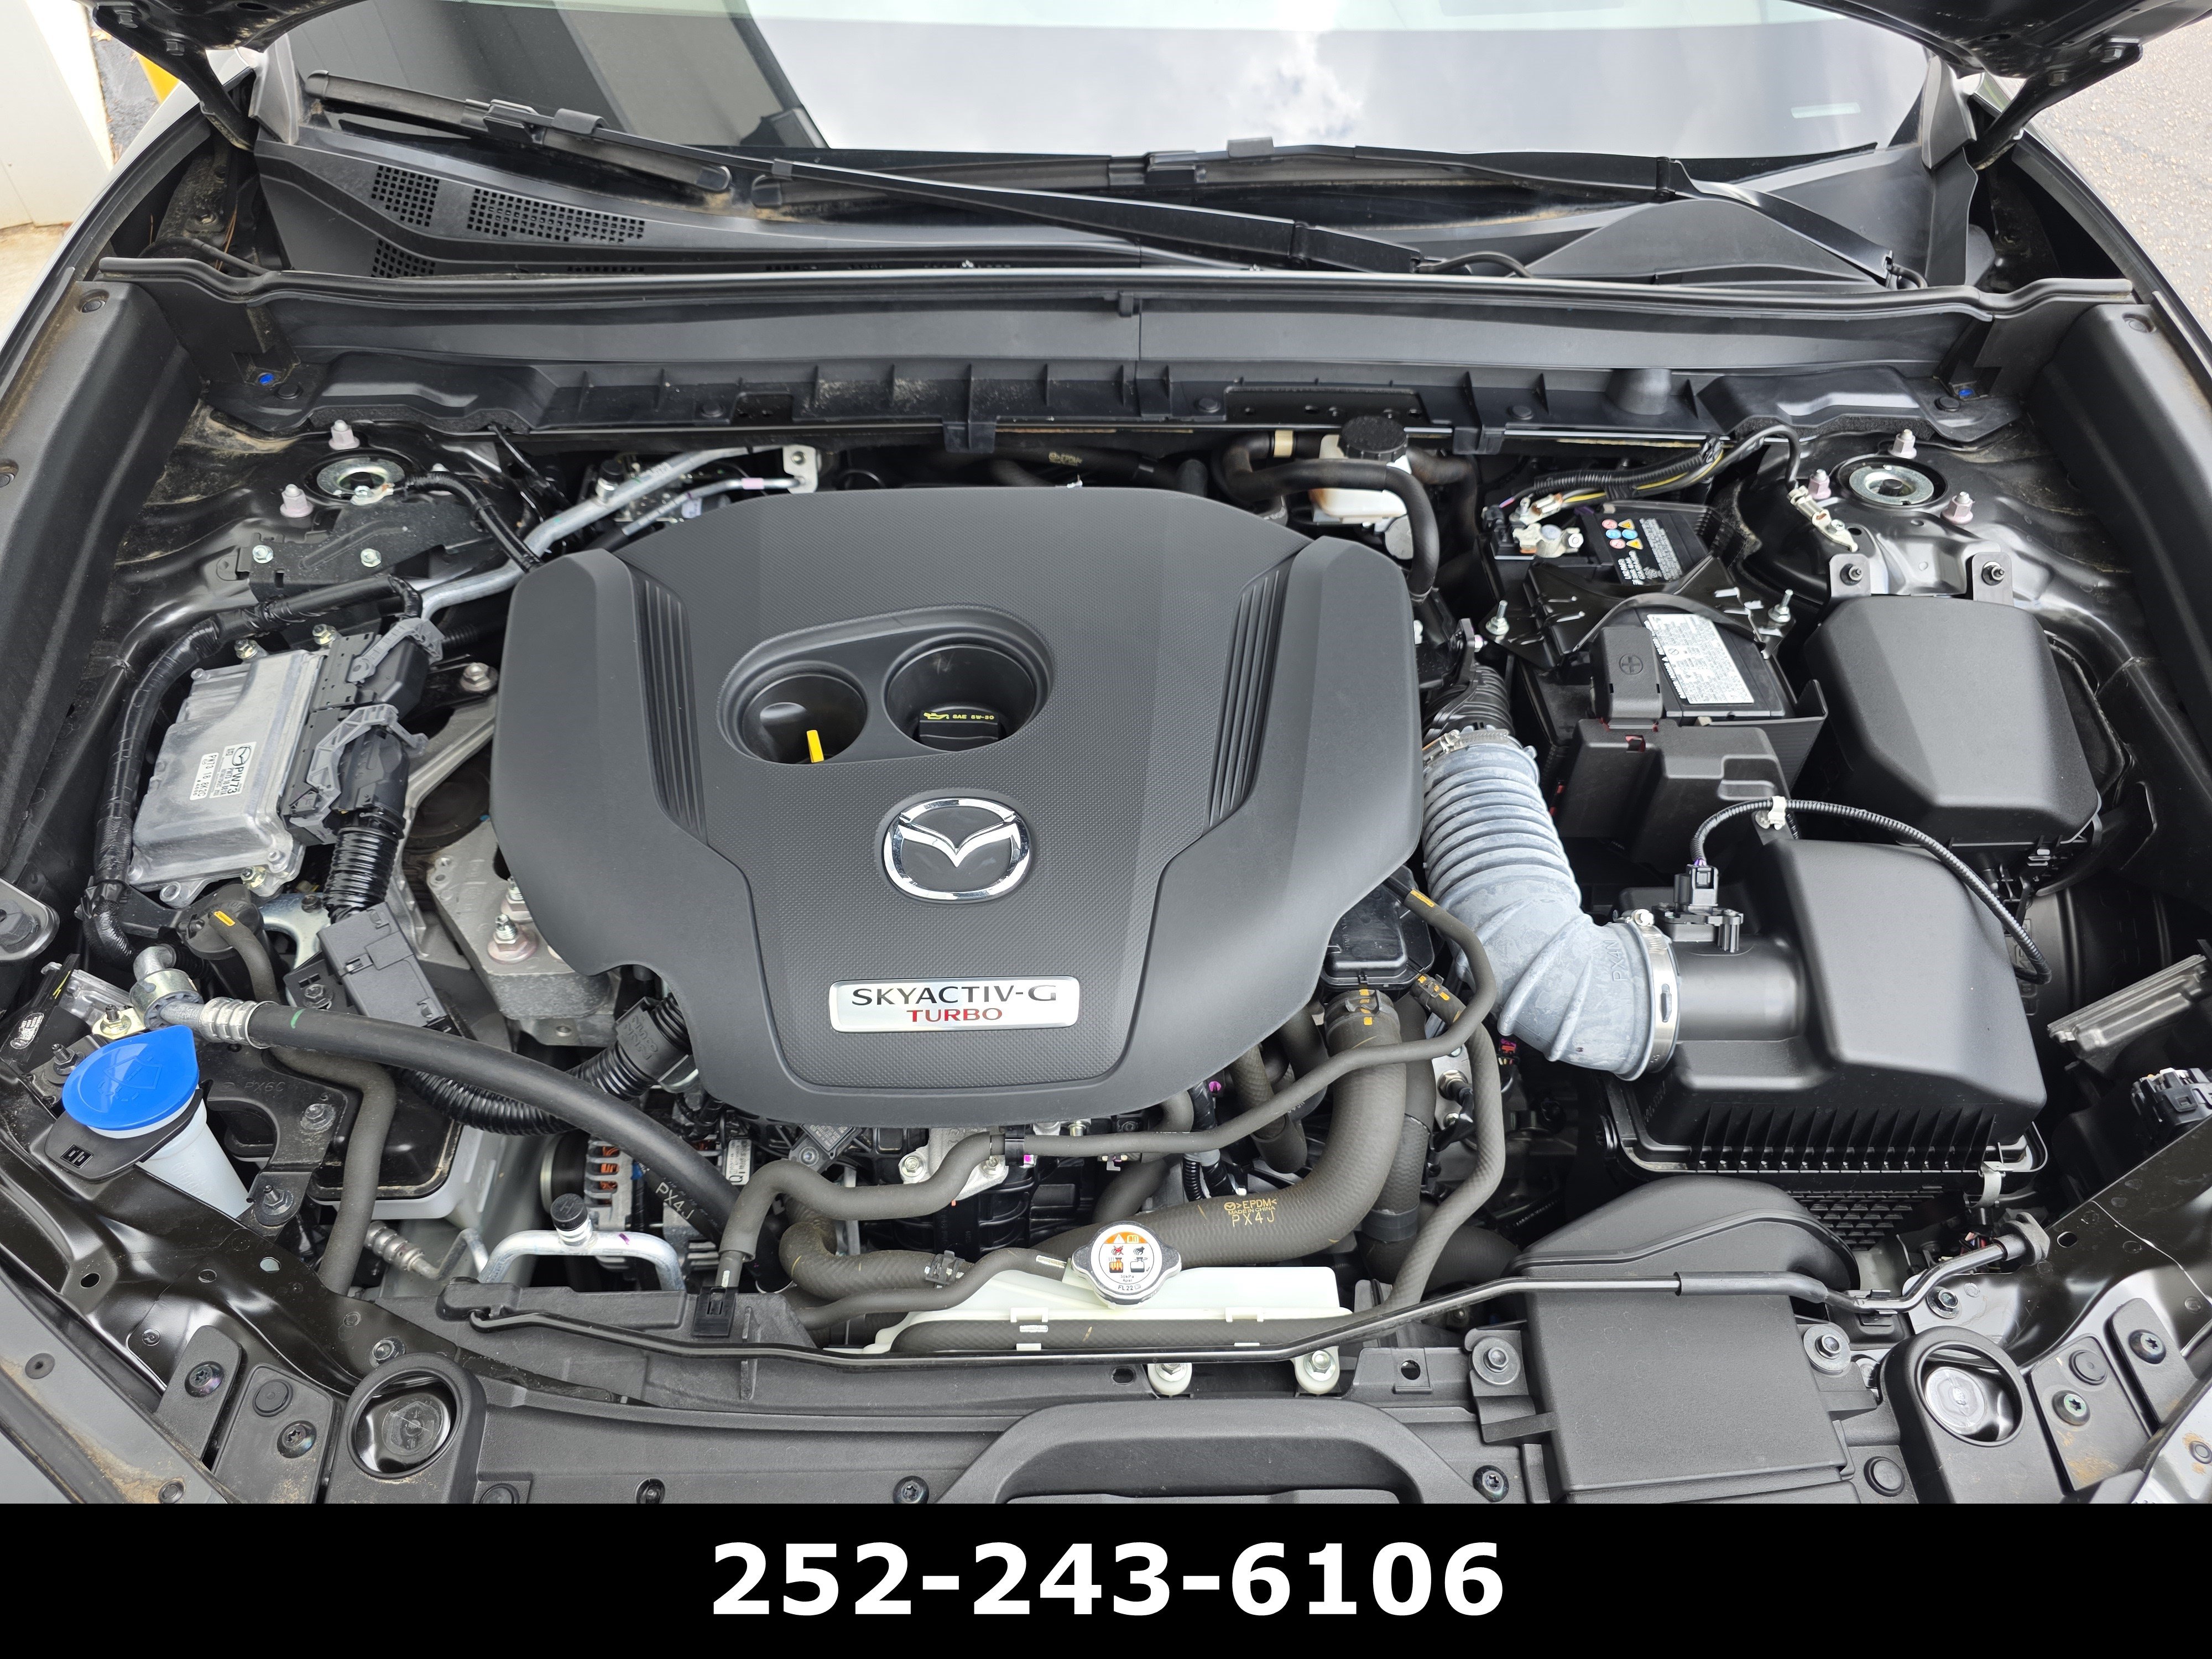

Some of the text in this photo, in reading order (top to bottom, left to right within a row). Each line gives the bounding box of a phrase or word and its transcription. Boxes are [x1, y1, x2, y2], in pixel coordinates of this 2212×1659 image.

[205, 755, 217, 769] PW73
[227, 766, 244, 794] PW73
[1603, 940, 1629, 982] PX4N
[852, 984, 1057, 1005] SKYACTIV-G
[906, 1008, 1003, 1022] TURBO
[655, 1181, 693, 1221] PX4J
[1232, 1210, 1275, 1228] PX4J
